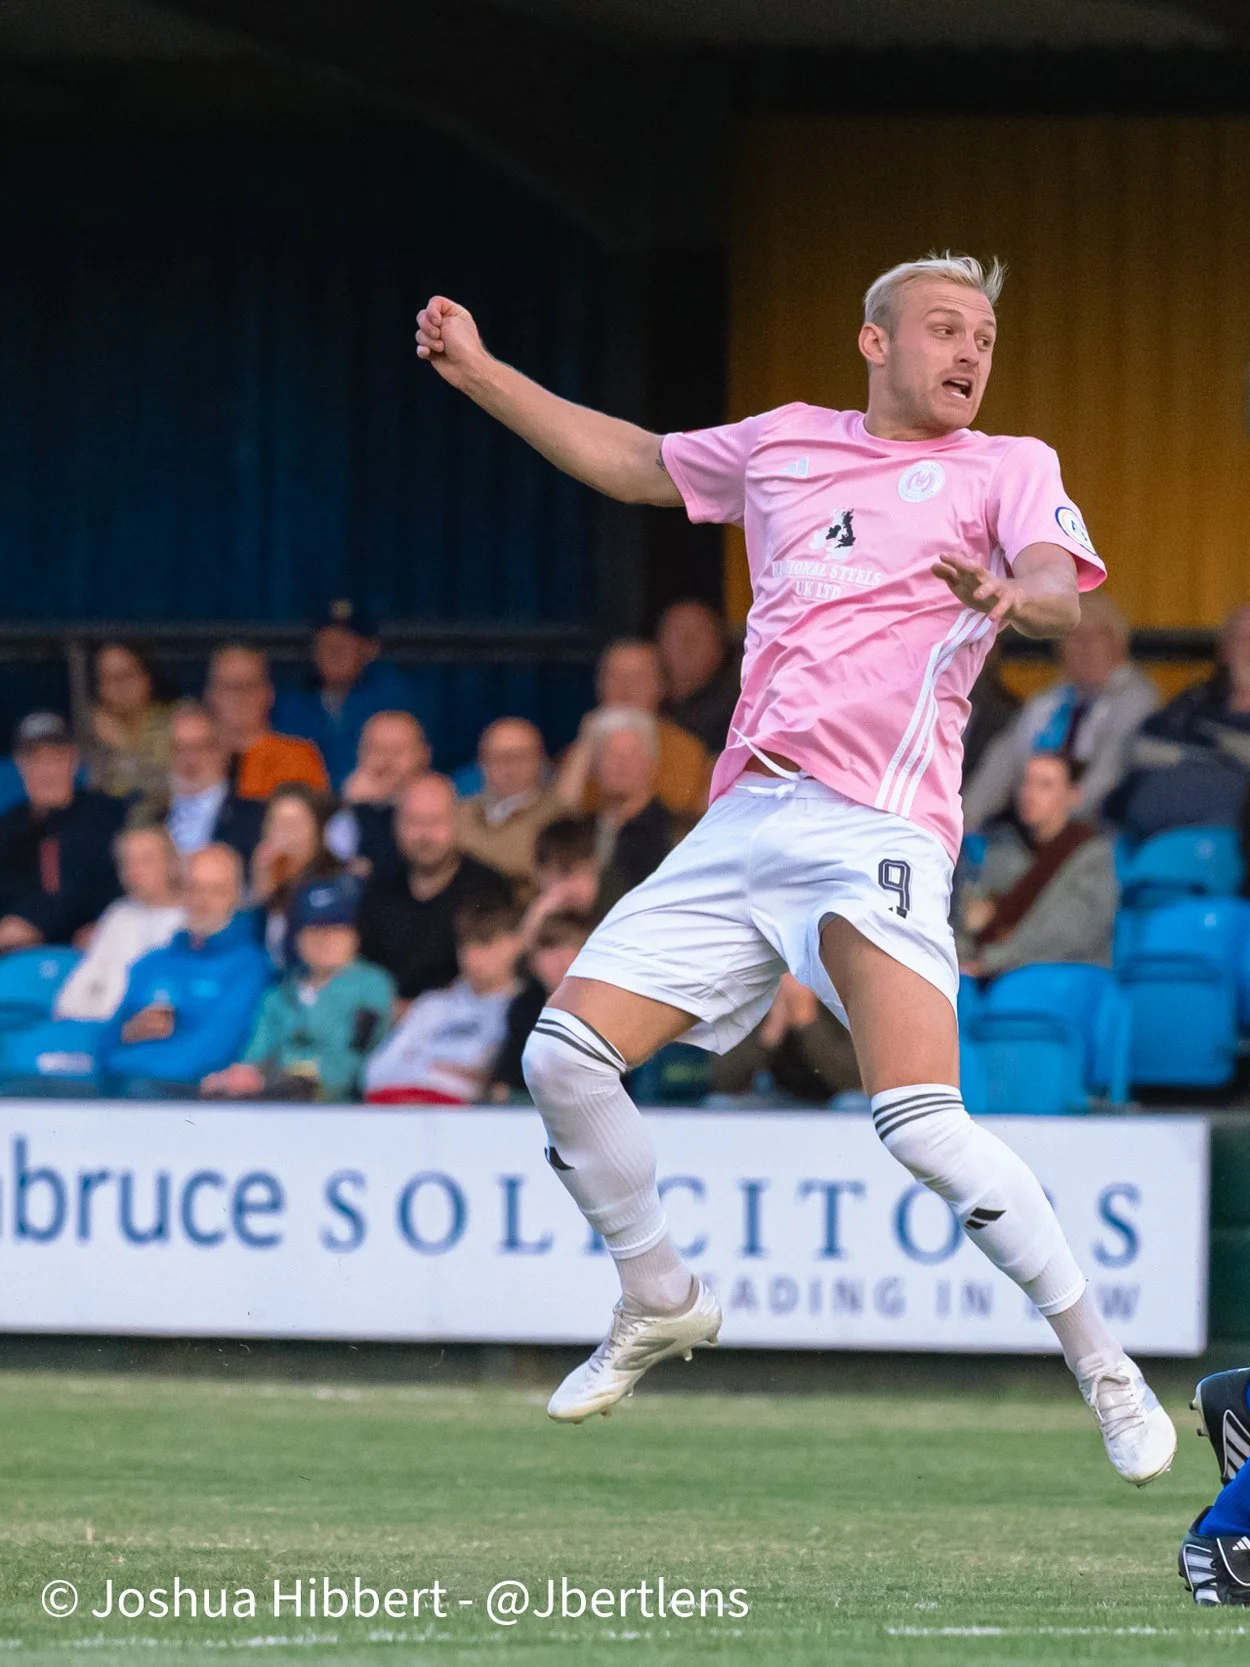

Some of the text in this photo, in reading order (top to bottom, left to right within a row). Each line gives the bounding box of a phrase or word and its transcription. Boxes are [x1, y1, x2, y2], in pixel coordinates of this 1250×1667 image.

[878, 858, 911, 911] 9
[0, 1133, 1143, 1269] bruce SOLCITOS
[698, 1272, 908, 1320] ADING
[934, 1280, 994, 1318] IN
